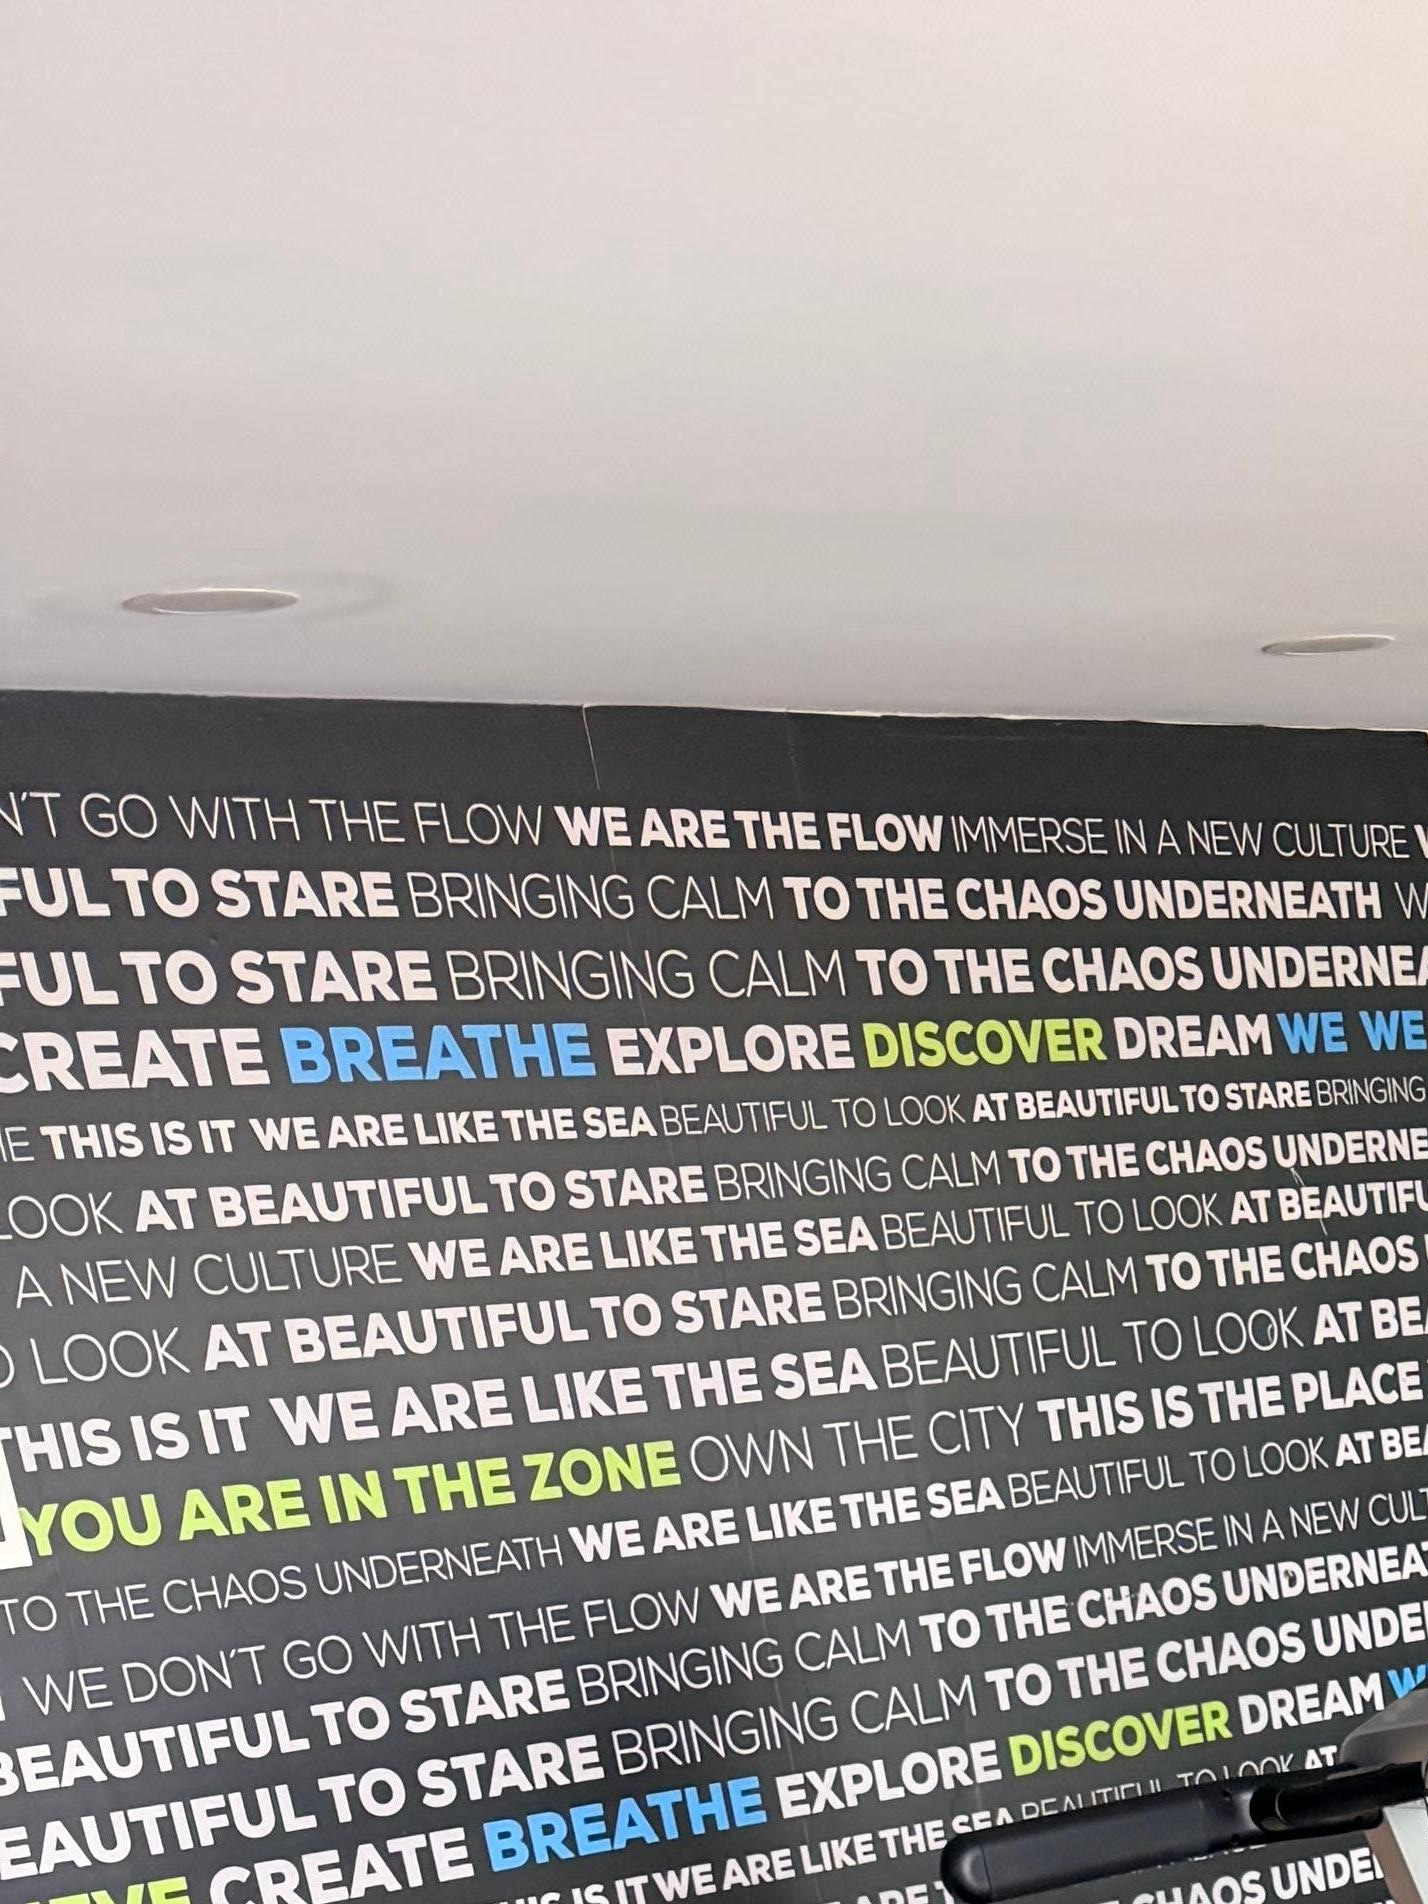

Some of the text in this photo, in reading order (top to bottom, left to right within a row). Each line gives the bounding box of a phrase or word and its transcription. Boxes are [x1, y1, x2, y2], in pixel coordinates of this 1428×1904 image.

[81, 793, 157, 838] GO
[169, 796, 300, 840] WITH
[309, 799, 405, 842] THE
[414, 802, 541, 845] FLOW
[554, 806, 632, 846] WE
[641, 808, 730, 848] ARE
[733, 811, 821, 849] THE
[827, 813, 943, 851] FLOW
[951, 816, 1107, 854] IMMERSE
[1115, 819, 1147, 854] IN
[1158, 820, 1181, 854] A
[1187, 821, 1262, 856] NEW
[1273, 822, 1409, 858] CULTURE
[0, 1028, 270, 1093] CREATE
[280, 1023, 596, 1083] BREATHE
[607, 1024, 855, 1075] EXPLORE
[863, 1018, 1107, 1068] DISCOVER
[1114, 1014, 1272, 1059] DREAM
[1277, 1012, 1347, 1053] WE
[1359, 1011, 1427, 1050] WE
[19, 1494, 161, 1557] YOU
[180, 1479, 310, 1540] ARE
[319, 1471, 387, 1523] IN
[393, 1457, 516, 1514] THE
[523, 1440, 681, 1501] ZONE
[691, 1427, 813, 1481] OWN
[823, 1415, 918, 1466] THE
[929, 1403, 1023, 1454] CITY
[1037, 1391, 1143, 1441] THIS
[1151, 1385, 1193, 1429] IS
[1198, 1376, 1285, 1423] THE
[1291, 1361, 1423, 1413] PLACE
[130, 1412, 189, 1461] IS
[199, 1406, 249, 1454] IT
[269, 1390, 379, 1445] WE
[392, 1379, 513, 1436] ARE
[521, 1367, 648, 1423] LIKE
[652, 1357, 762, 1409] THE
[771, 1348, 878, 1399] SEA
[881, 1326, 1116, 1388] BEAUTIFUL
[1122, 1318, 1181, 1363] TO
[1194, 1307, 1303, 1356] LOOK
[1314, 1302, 1362, 1345] AT
[22, 1667, 113, 1715] WE
[122, 1645, 265, 1702] DON'T
[283, 1635, 352, 1679] GO
[362, 1617, 480, 1667] WITH
[488, 1605, 575, 1649] THE
[583, 1587, 698, 1637] FLOW
[710, 1577, 782, 1618] WE
[790, 1565, 871, 1609] ARE
[874, 1554, 954, 1595] THE
[959, 1537, 1066, 1585] FLOW
[1073, 1517, 1217, 1568] IMMERSE
[1224, 1513, 1253, 1546] IN
[1263, 1509, 1284, 1542] A
[1290, 1498, 1359, 1538] NEW
[310, 1697, 389, 1745] TO
[400, 1669, 570, 1732] STARE
[577, 1638, 783, 1705] BRINGING
[795, 1619, 911, 1671] CALM
[919, 1609, 980, 1652] TO
[985, 1595, 1070, 1642] THE
[1078, 1574, 1217, 1628] CHAOS
[483, 1776, 767, 1872] BREATHE
[776, 1740, 1002, 1818] EXPLORE
[1009, 1701, 1232, 1784] DISCOVER
[1239, 1673, 1384, 1734] DREAM
